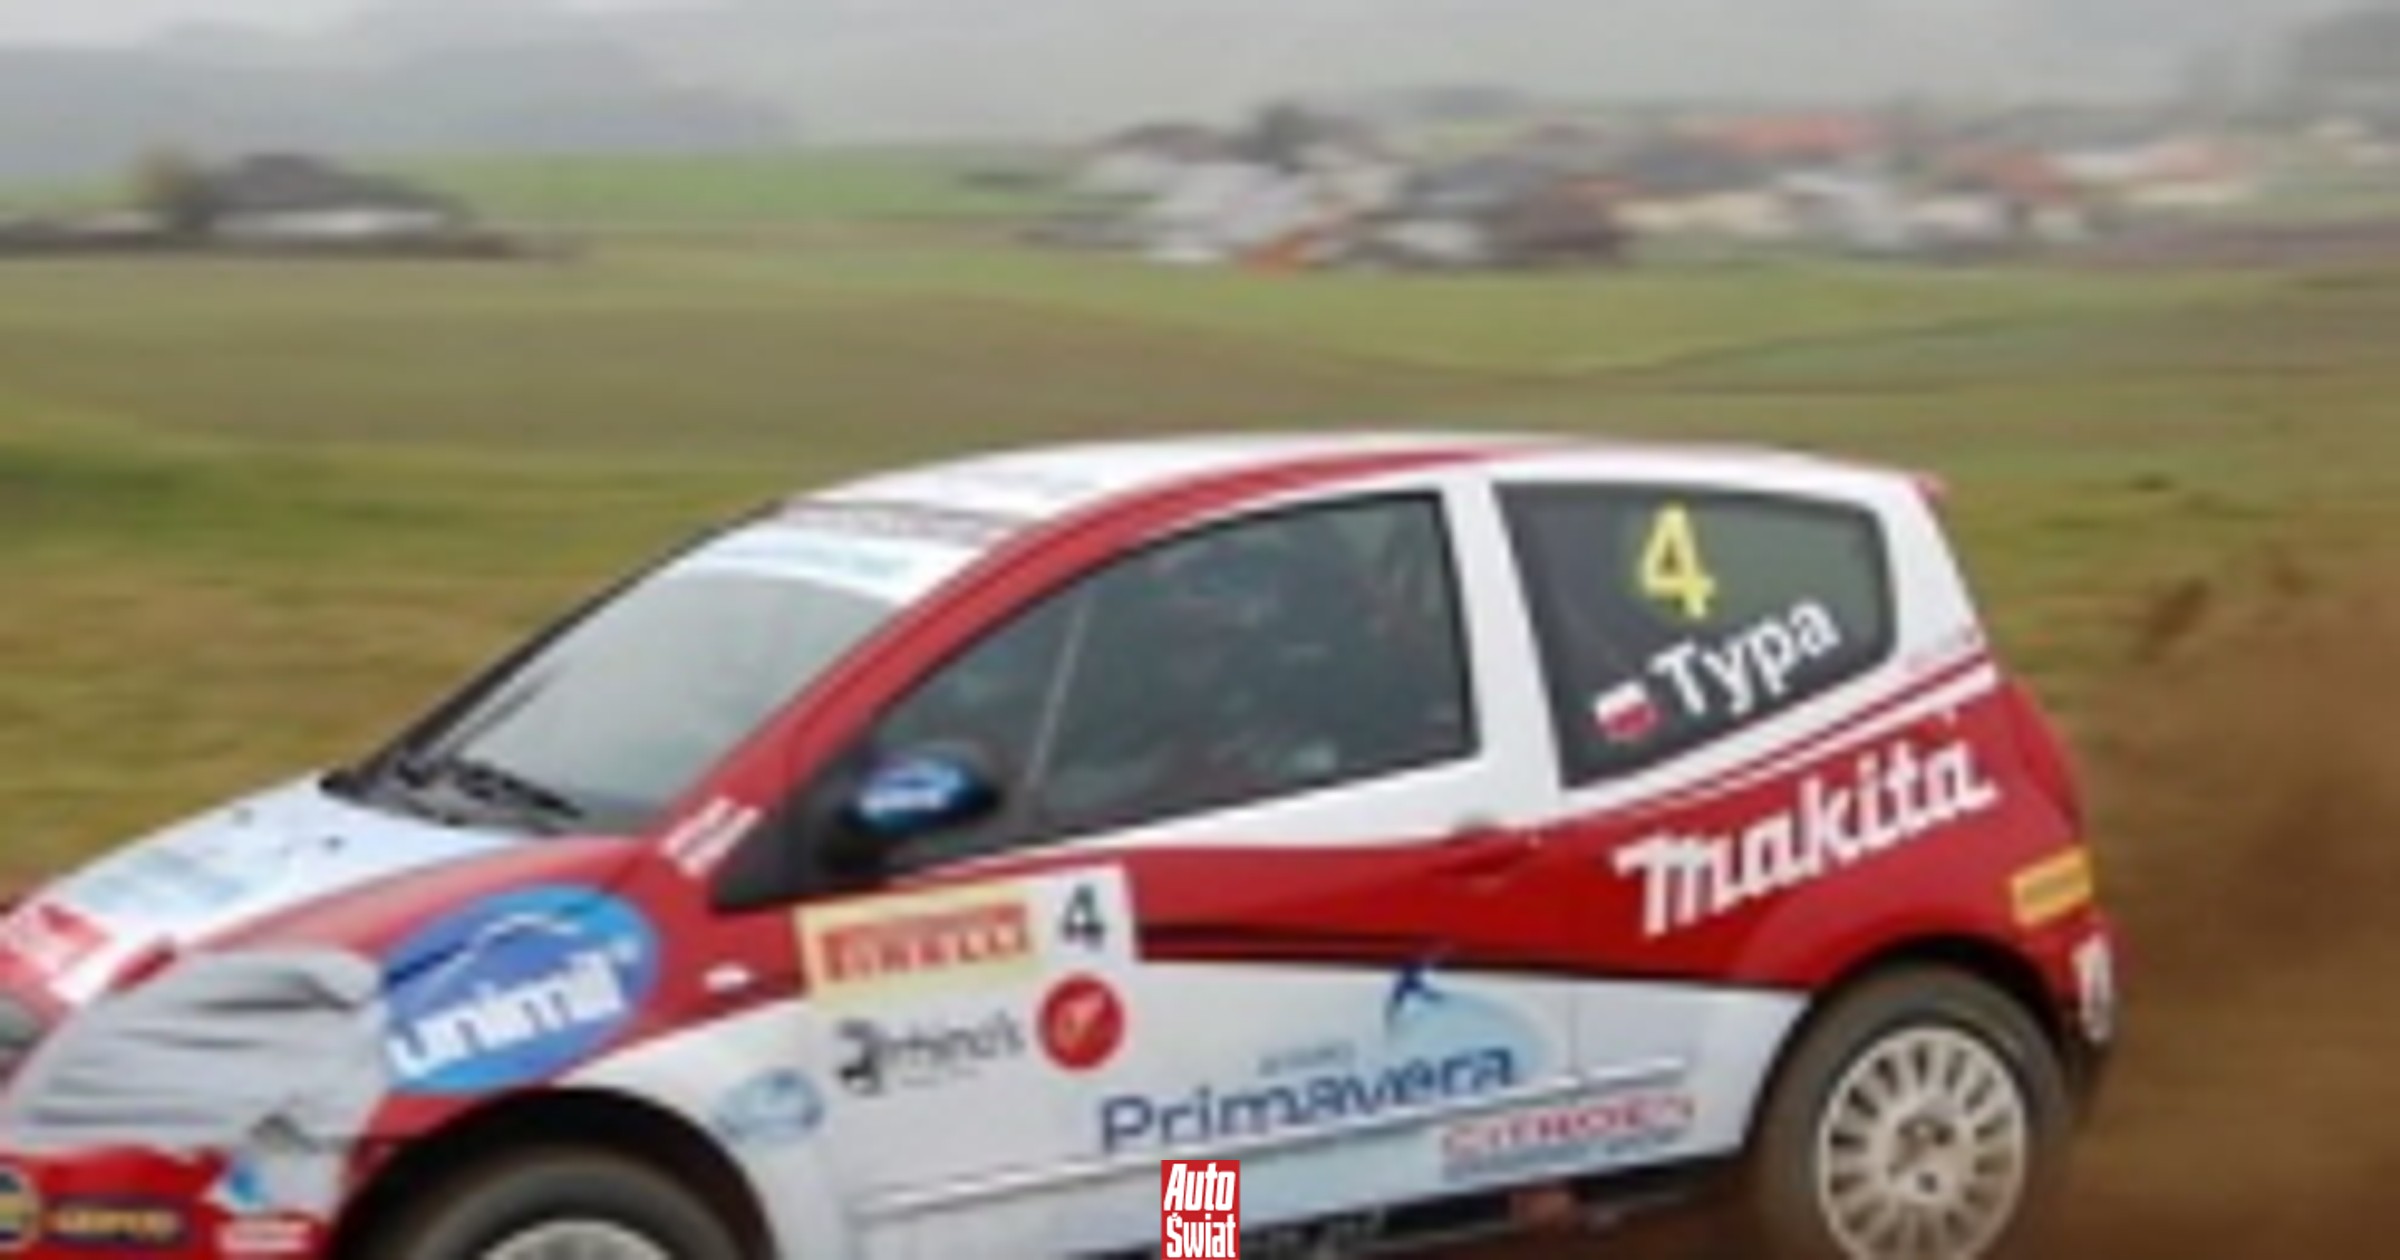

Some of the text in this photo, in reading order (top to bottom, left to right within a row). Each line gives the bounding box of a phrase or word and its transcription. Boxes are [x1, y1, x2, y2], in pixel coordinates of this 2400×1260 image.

[1641, 504, 1716, 618] 4
[1648, 600, 1838, 714] Typa
[1061, 884, 1106, 950] 4
[1101, 1047, 1515, 1154] Primavera
